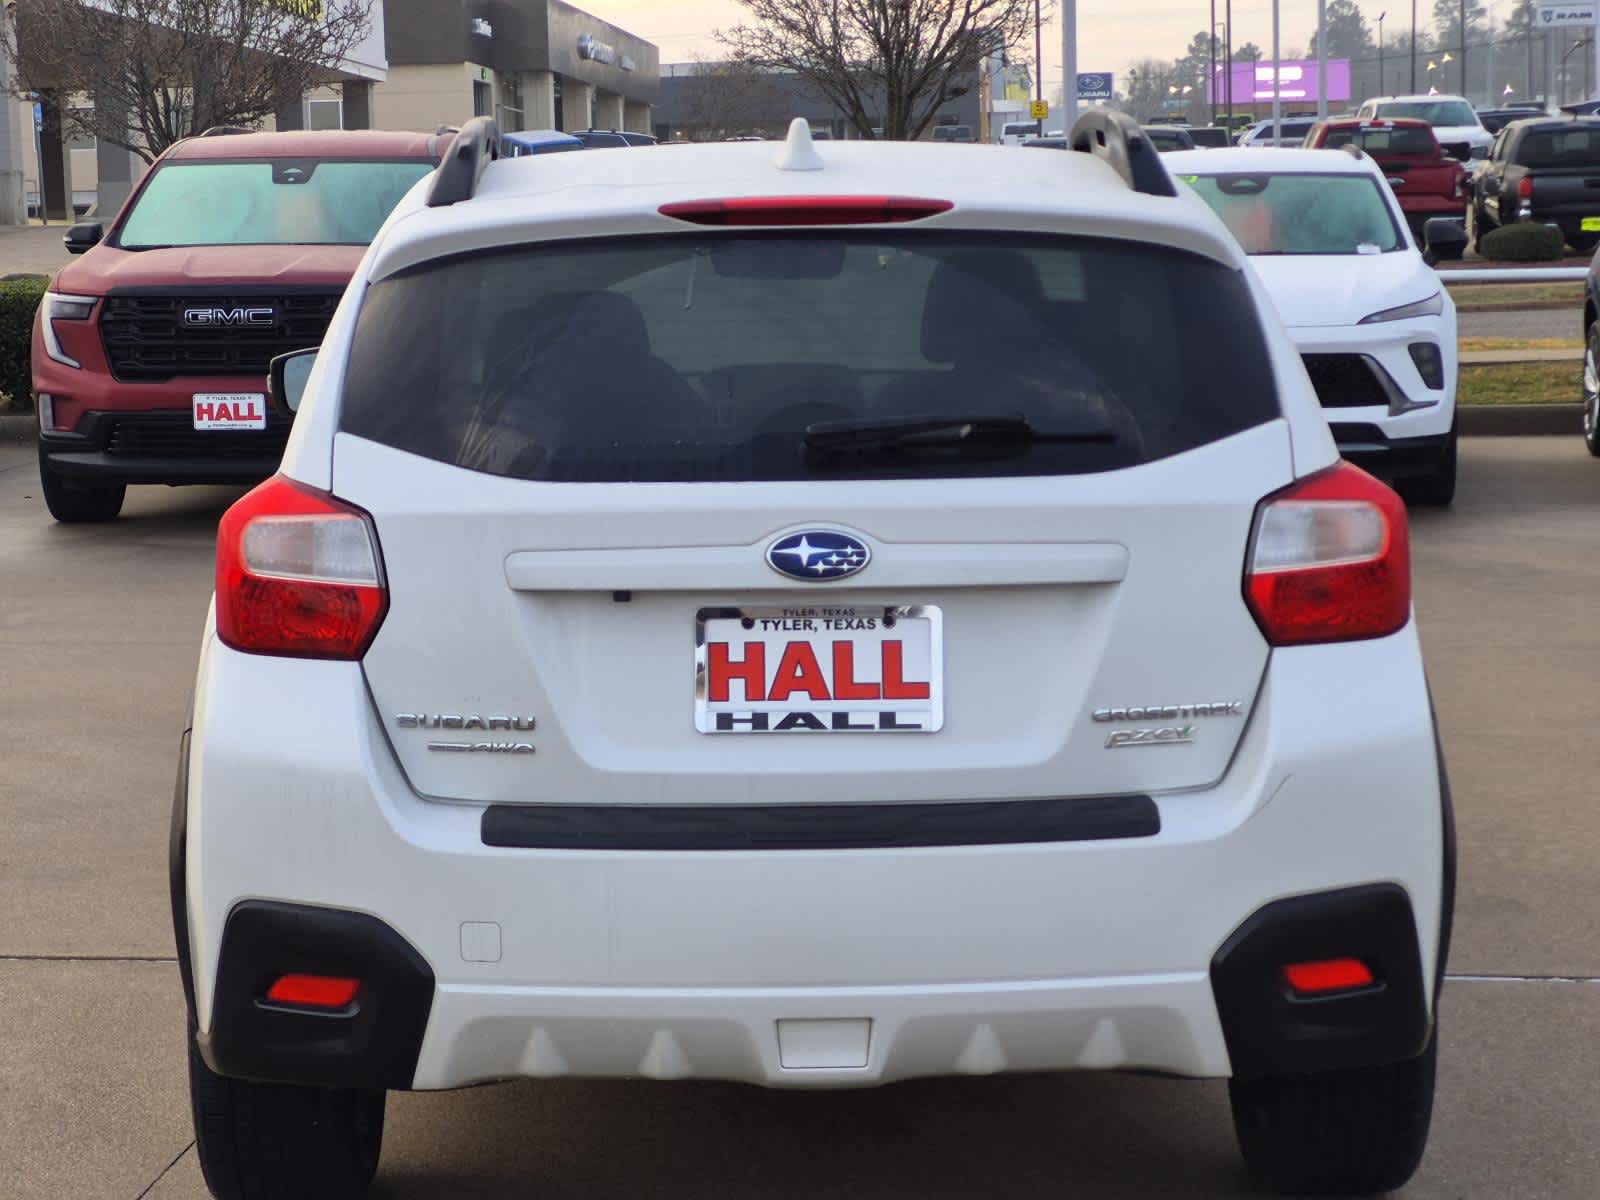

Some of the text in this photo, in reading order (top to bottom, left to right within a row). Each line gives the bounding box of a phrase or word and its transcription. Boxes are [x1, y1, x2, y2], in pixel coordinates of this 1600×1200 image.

[185, 308, 273, 326] GMC
[196, 403, 262, 421] HALL
[783, 607, 856, 618] TYLER, TEXAS
[761, 619, 877, 632] TYLER, TEXAS
[708, 640, 930, 702] HALL
[1092, 701, 1242, 722] CROSSTREK
[396, 713, 536, 730] SUBARU
[716, 712, 922, 730] HALL
